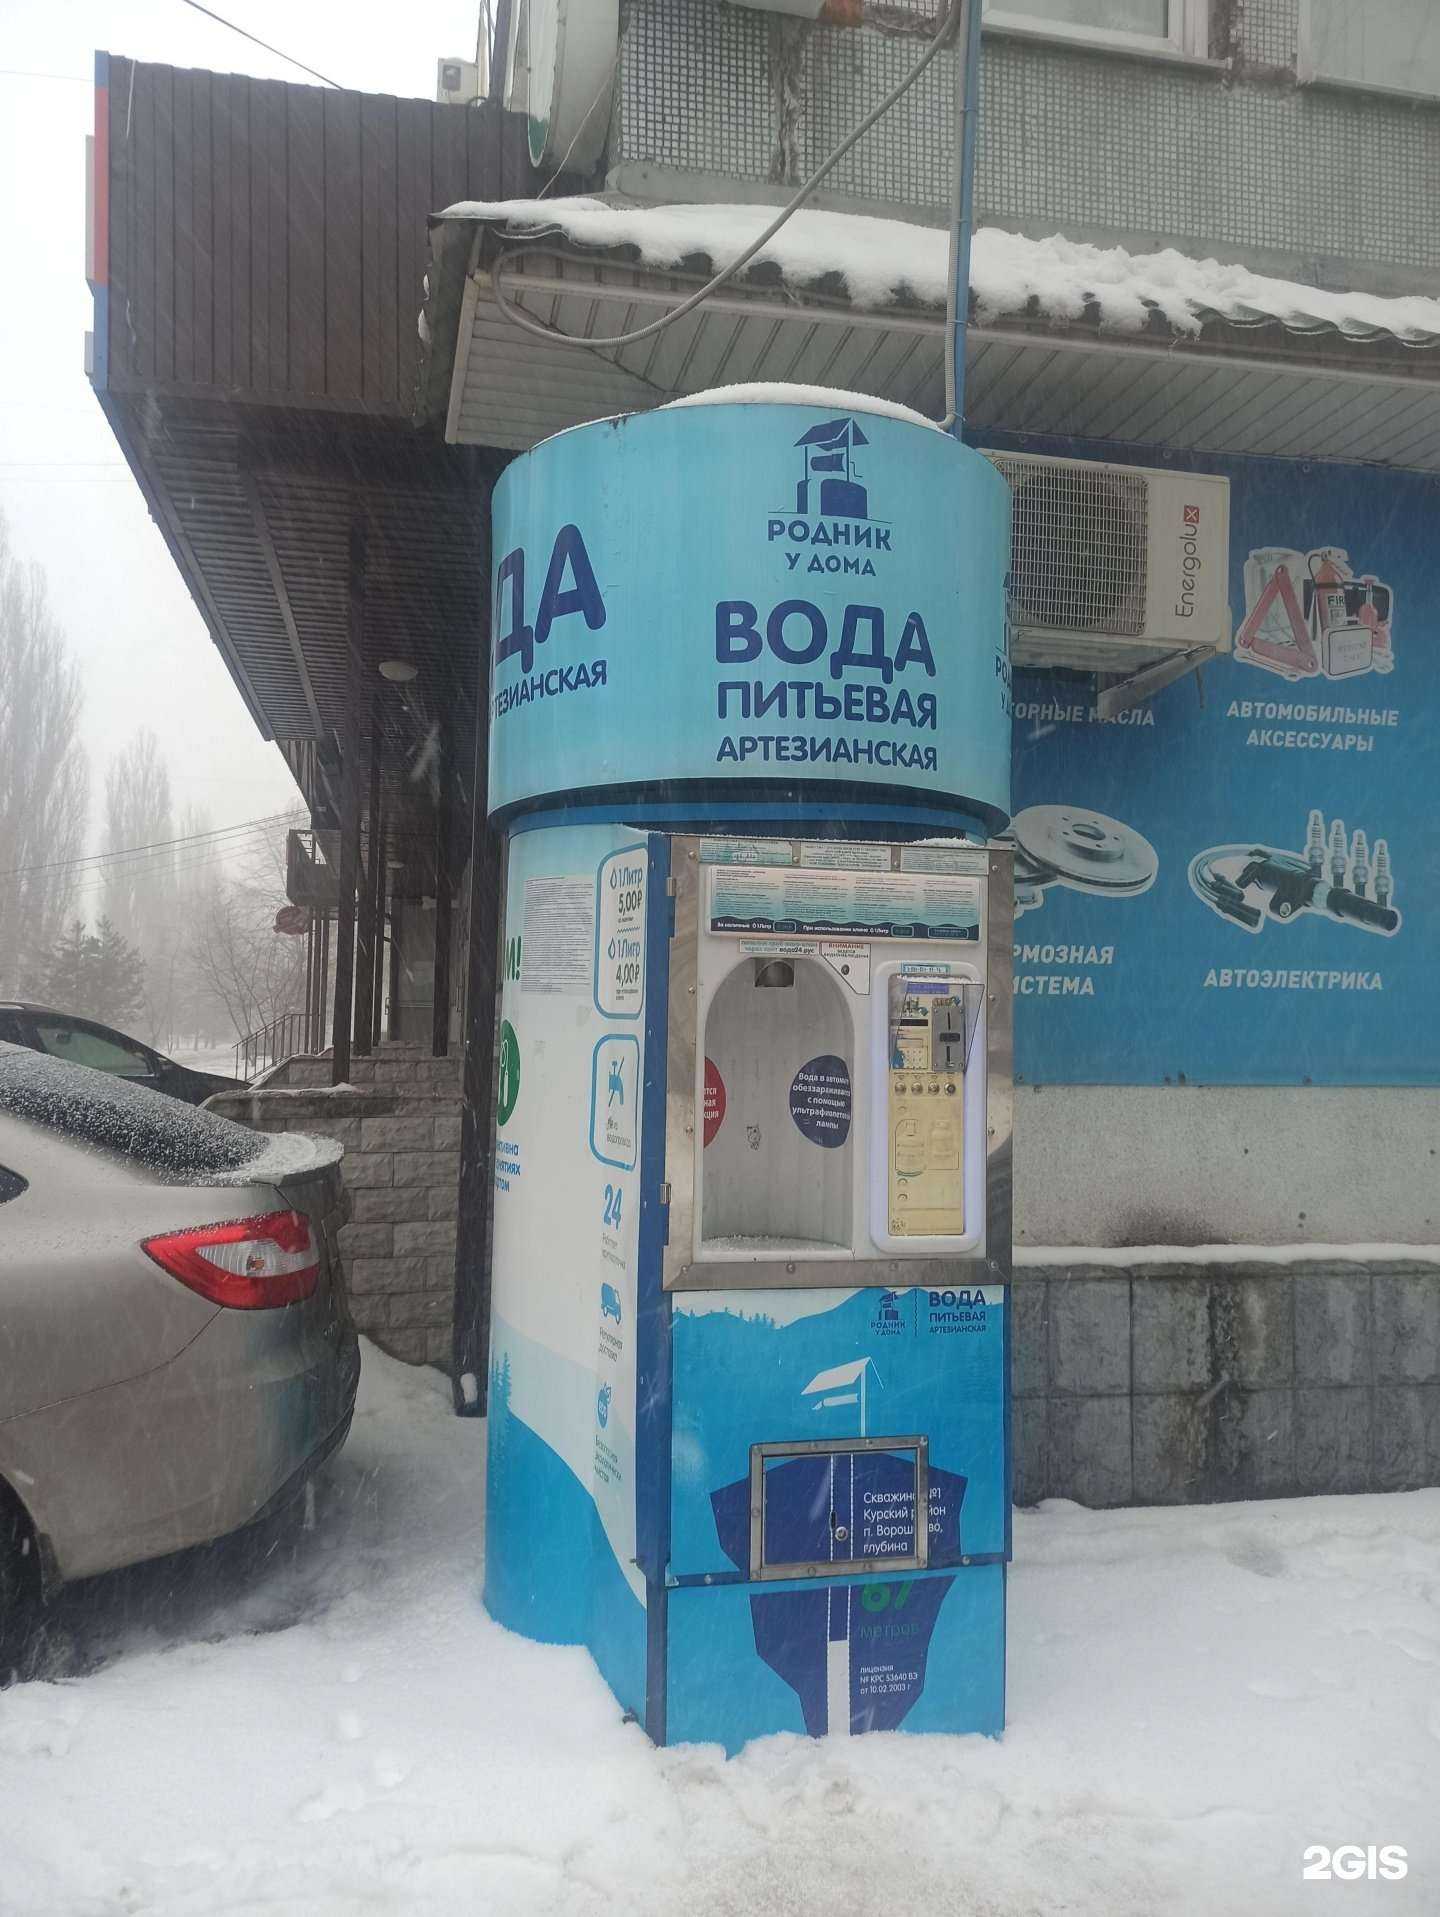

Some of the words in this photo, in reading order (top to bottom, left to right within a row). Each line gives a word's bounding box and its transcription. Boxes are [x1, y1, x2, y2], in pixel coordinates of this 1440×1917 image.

[768, 518, 892, 552] РОДНИК
[785, 552, 801, 571] У
[807, 555, 877, 577] ДОМА
[1175, 505, 1201, 618] Energolux
[715, 599, 937, 684] ВОДА
[717, 681, 938, 730] ПИТЬЕВАЯ
[1011, 702, 1084, 722] ОРНЫЕ
[1088, 707, 1155, 726] МСЛА
[1226, 700, 1399, 726] АВТОМОБИЛЬНЫЕ
[1246, 729, 1375, 752] АКСЕССУАРЫ
[716, 735, 938, 772] АРТЕЗИАНСКАЯ
[1204, 968, 1383, 991] АВТОЭЛЕКТРИКА
[798, 1072, 819, 1082] Вода
[813, 1098, 846, 1108] помощью
[603, 1183, 622, 1230] 24
[928, 1289, 986, 1309] ВОДА
[870, 1321, 905, 1329] РОДНИК
[929, 1311, 986, 1323] ПИТЬЕВАЯ
[929, 1325, 987, 1334] АРТЕЗИАНСКАЯ
[863, 1505, 908, 1523] Курский
[911, 1505, 946, 1519] рйон
[863, 1529, 873, 1537] п.
[863, 1541, 908, 1555] глубина
[870, 1674, 885, 1683] КРС
